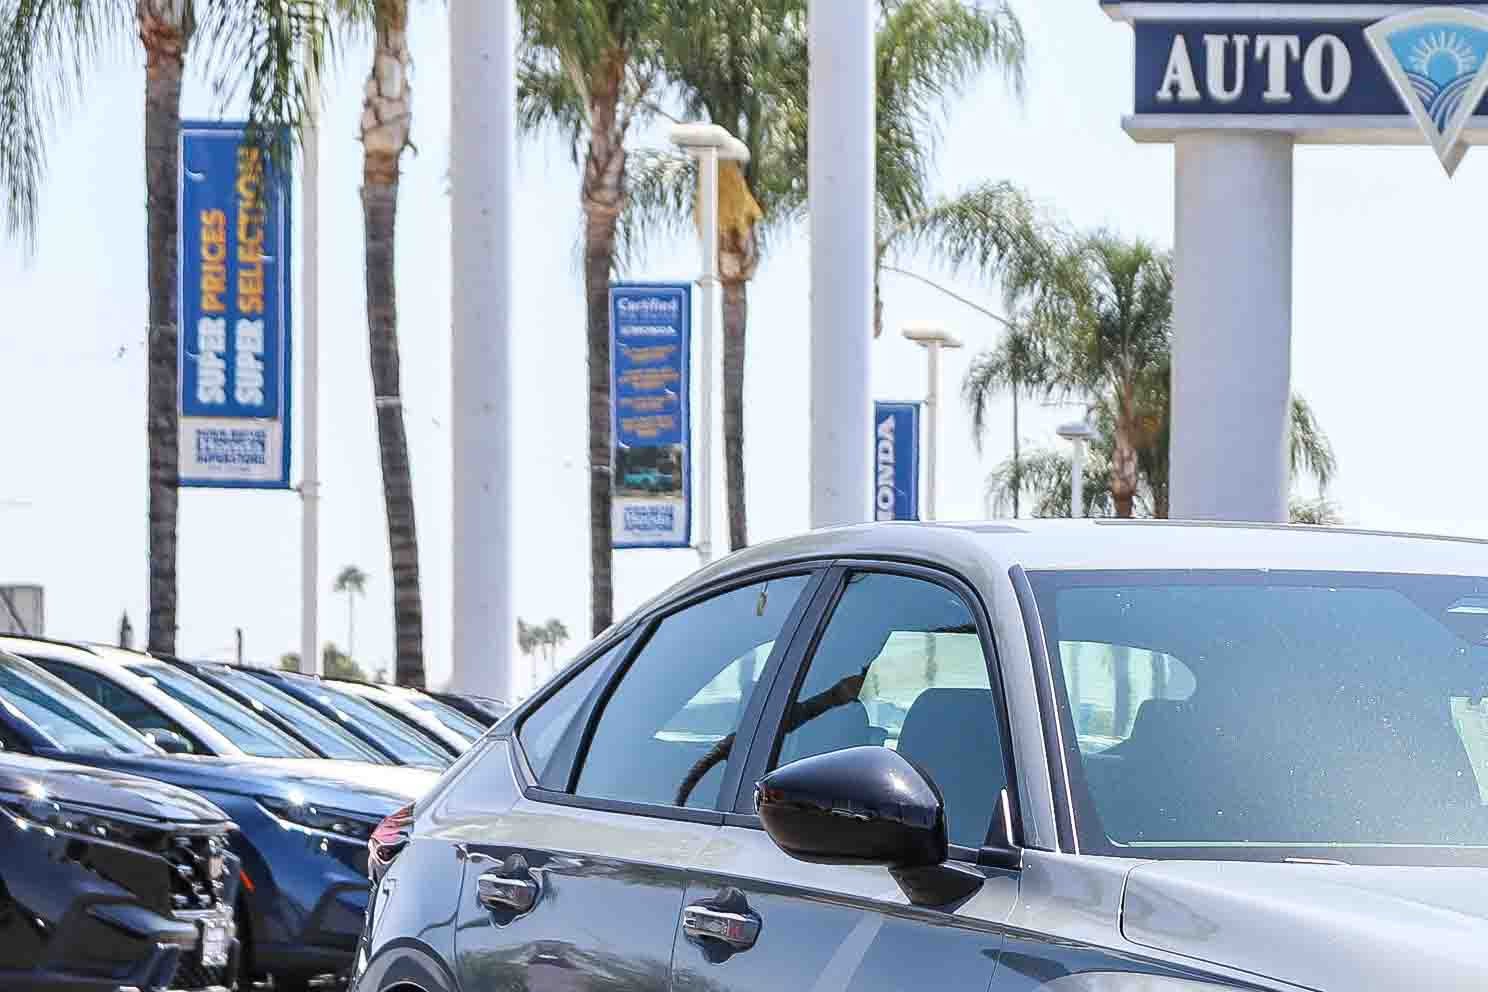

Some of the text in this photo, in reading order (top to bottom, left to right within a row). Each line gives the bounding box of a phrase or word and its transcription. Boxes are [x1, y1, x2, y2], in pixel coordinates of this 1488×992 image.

[1156, 33, 1352, 102] AUTO
[196, 208, 227, 404] SUPER PRICES
[234, 146, 265, 405] SUPER SELECTION
